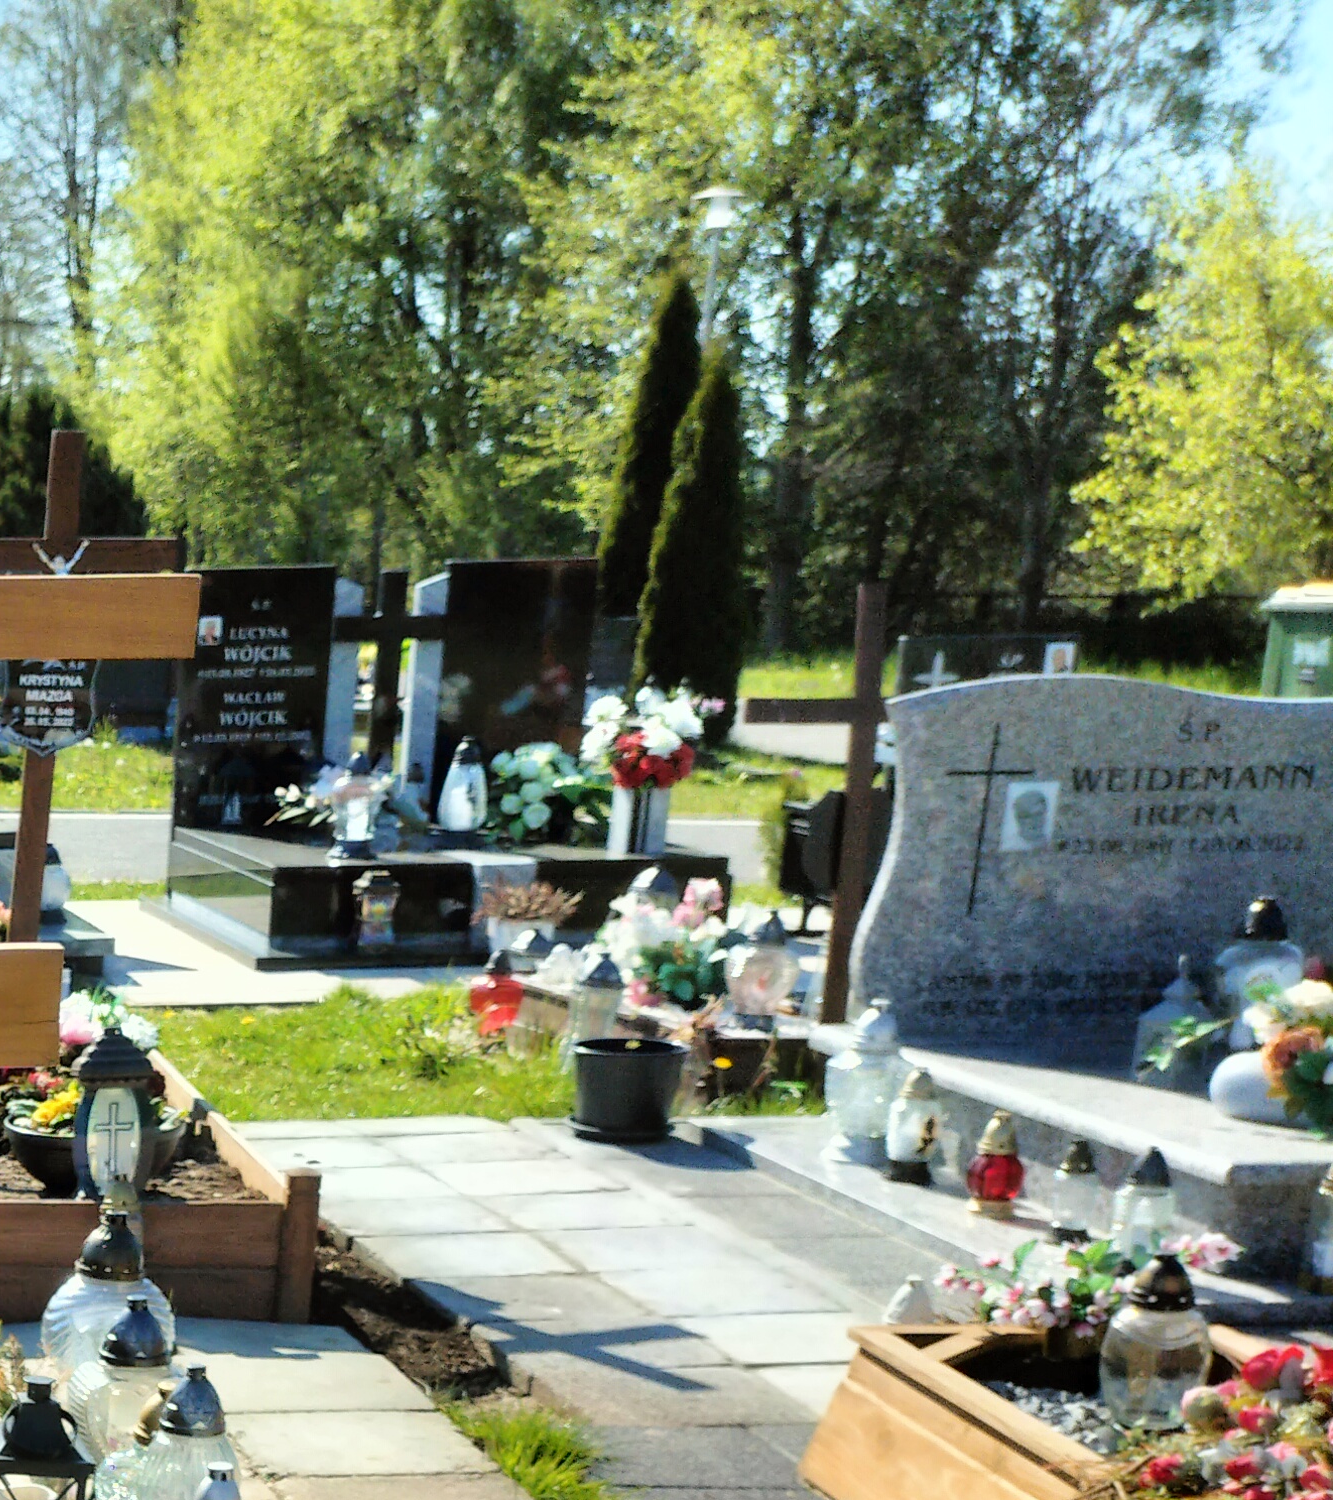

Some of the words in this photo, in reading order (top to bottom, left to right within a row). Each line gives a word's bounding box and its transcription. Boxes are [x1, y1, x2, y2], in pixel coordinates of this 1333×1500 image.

[224, 645, 293, 665] WÓJCIK
[18, 673, 84, 687] KRYSTYNA
[219, 708, 288, 728] WÓJCIK
[1071, 765, 1315, 793] WEIDEMANN
[1133, 805, 1240, 826] IRENA
